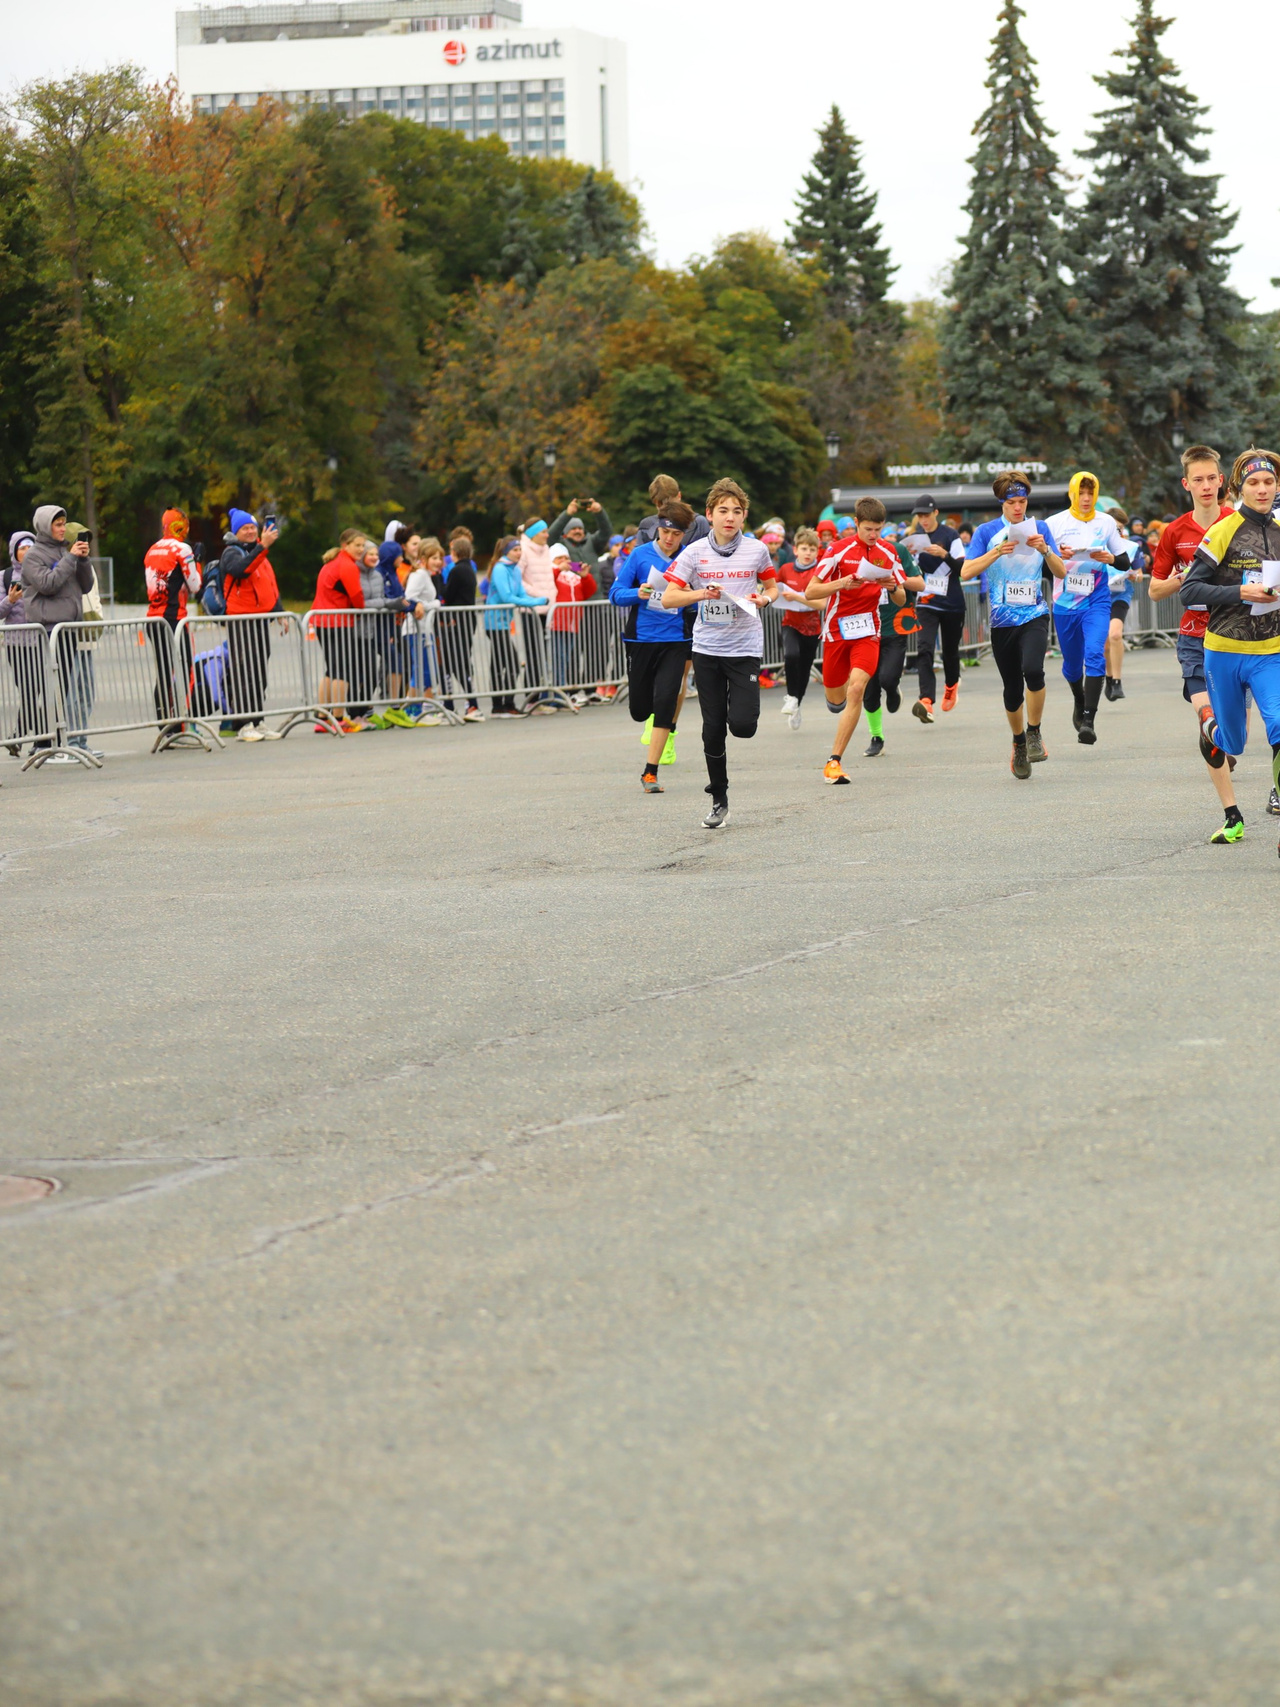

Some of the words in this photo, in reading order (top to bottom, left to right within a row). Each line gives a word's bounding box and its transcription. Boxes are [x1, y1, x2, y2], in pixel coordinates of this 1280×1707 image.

[476, 38, 563, 62] azimut
[886, 463, 980, 477] УЛЬЯНОВСКАЯ
[986, 461, 1048, 474] ОБЛАСТЬ
[697, 571, 724, 579] NORD
[727, 570, 755, 579] WEST
[1067, 577, 1090, 587] 304.1
[1007, 587, 1032, 596] 305.1
[704, 604, 731, 616] 342.1
[844, 619, 868, 632] 322.1
